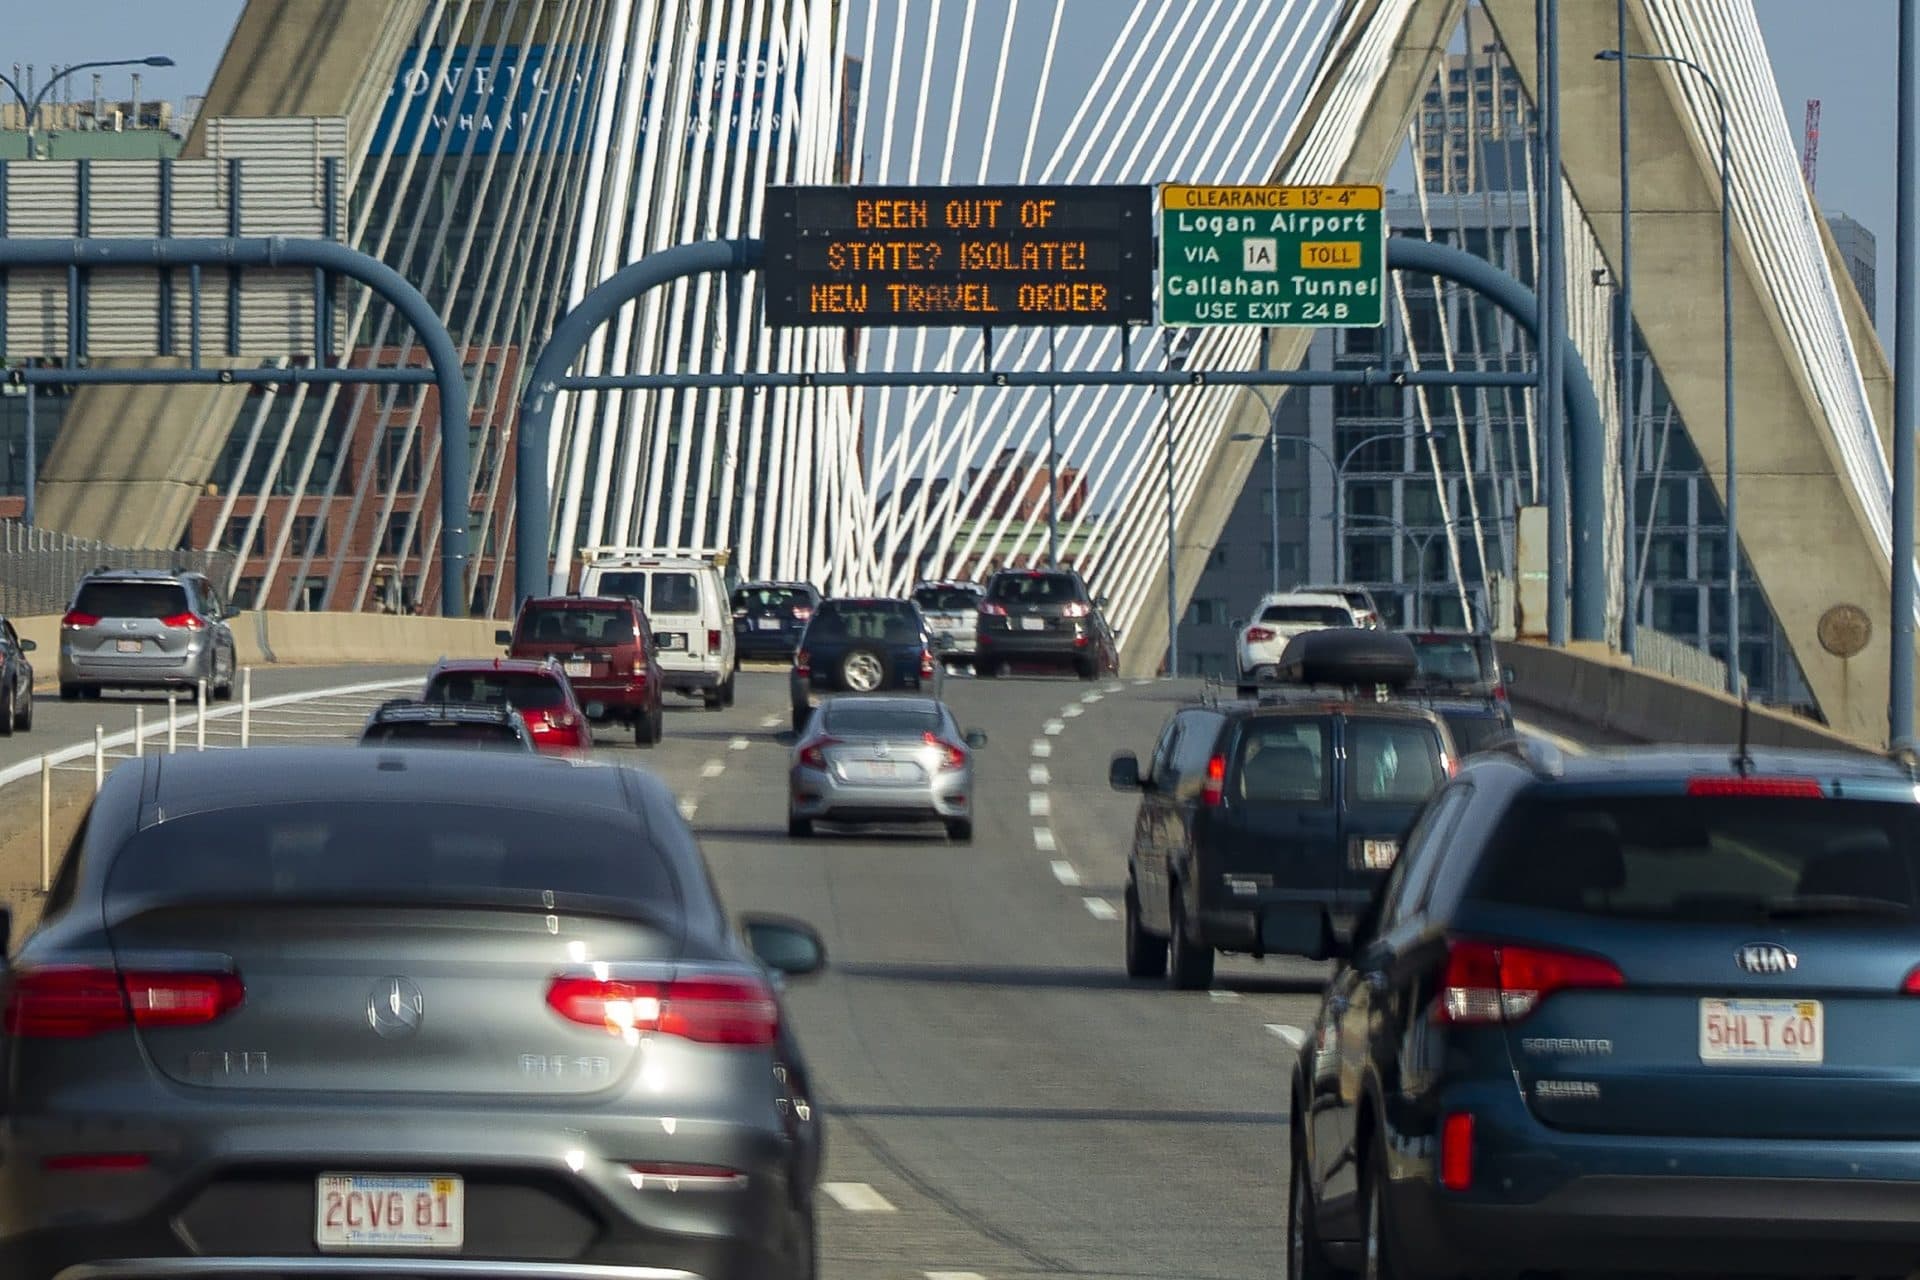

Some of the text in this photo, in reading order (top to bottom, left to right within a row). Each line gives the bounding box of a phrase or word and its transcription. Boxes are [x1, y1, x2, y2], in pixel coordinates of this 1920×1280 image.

[1186, 190, 1289, 206] CLEARANCE
[856, 200, 1056, 228] BEEN OUT OF
[1179, 212, 1367, 237] Logan Airport
[828, 241, 1088, 271] STATE? ISOLATE!
[1184, 247, 1353, 265] VIA 1A TOLL
[810, 283, 1108, 312] NEW TRAVEL ORDER
[1167, 276, 1378, 296] Callahan Tunnel
[1195, 303, 1238, 319] USE
[1248, 303, 1293, 319] EXIT
[1707, 1014, 1816, 1046] 5HLT 60
[325, 1191, 452, 1228] 2CVG 81
